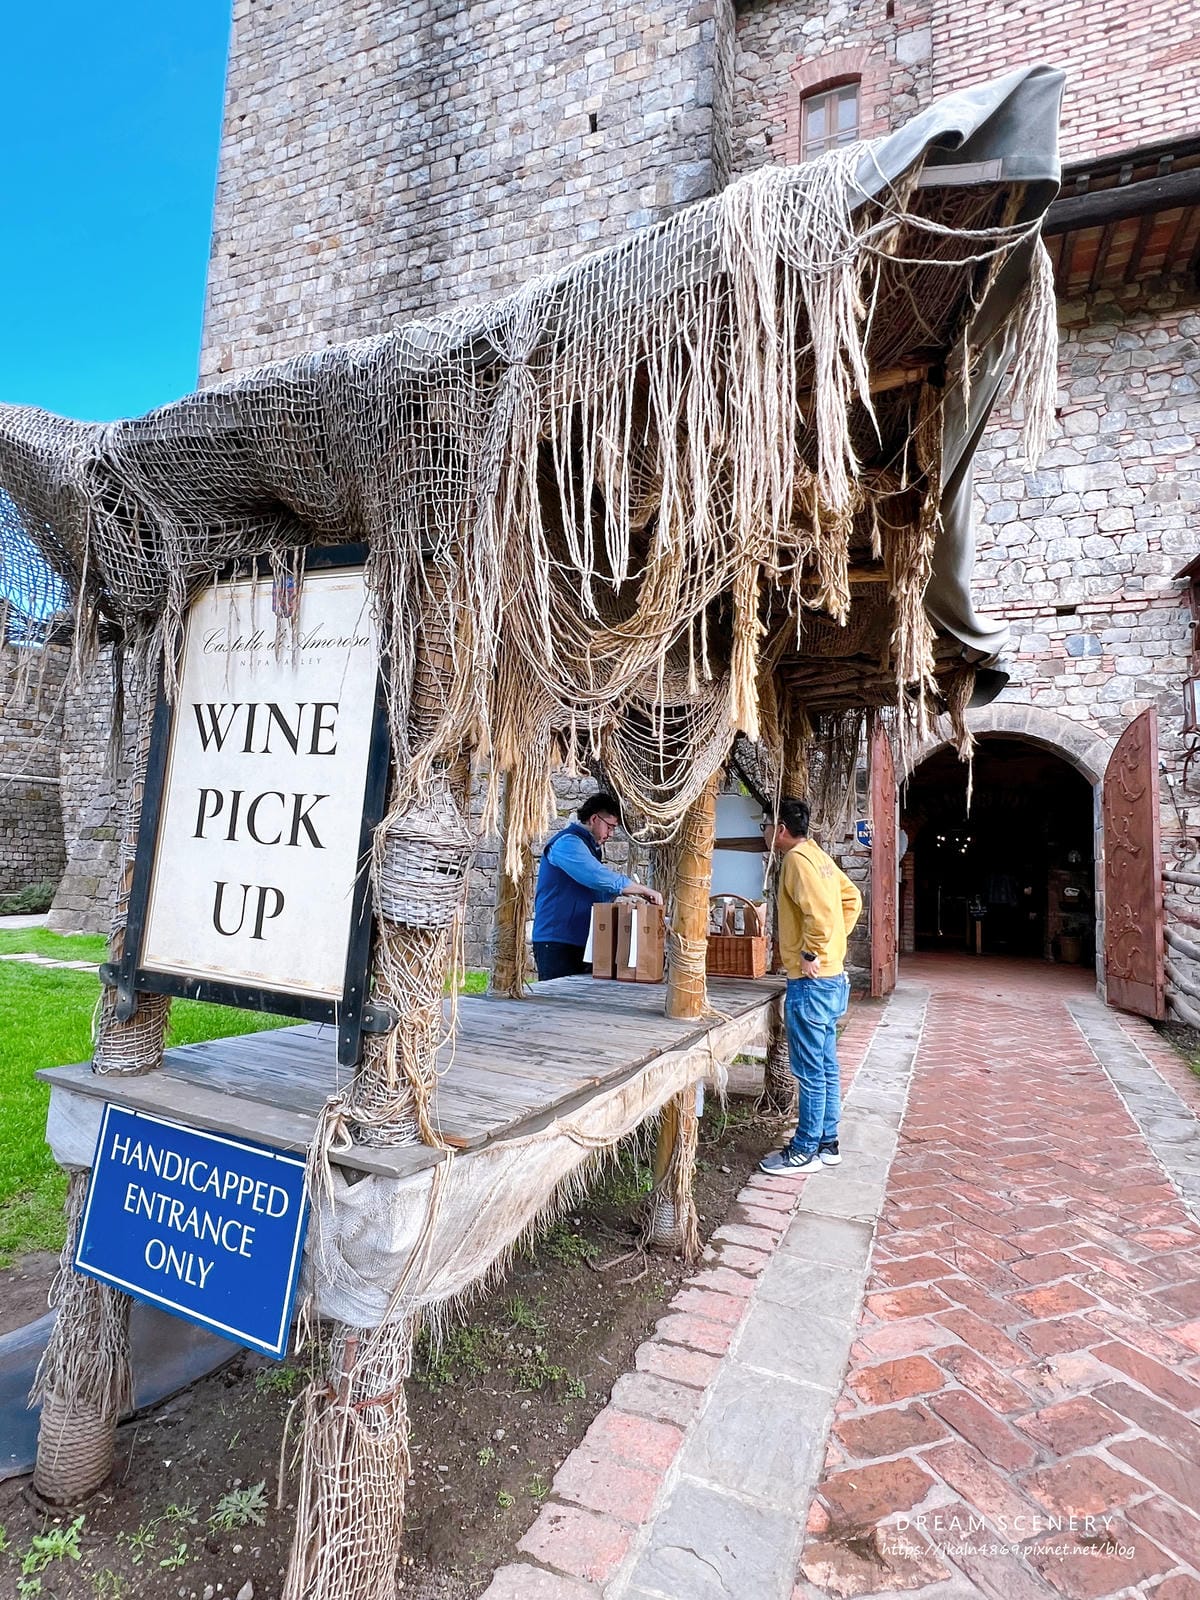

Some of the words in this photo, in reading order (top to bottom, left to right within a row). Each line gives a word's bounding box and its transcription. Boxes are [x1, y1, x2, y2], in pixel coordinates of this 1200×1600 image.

[287, 622, 370, 652] Amorosa
[192, 702, 339, 755] WINE
[190, 788, 330, 849] PICK
[212, 881, 285, 940] UP
[110, 1134, 289, 1217] HANDICAPPED
[124, 1183, 256, 1258] ENTRANCE
[144, 1239, 214, 1289] ONLY
